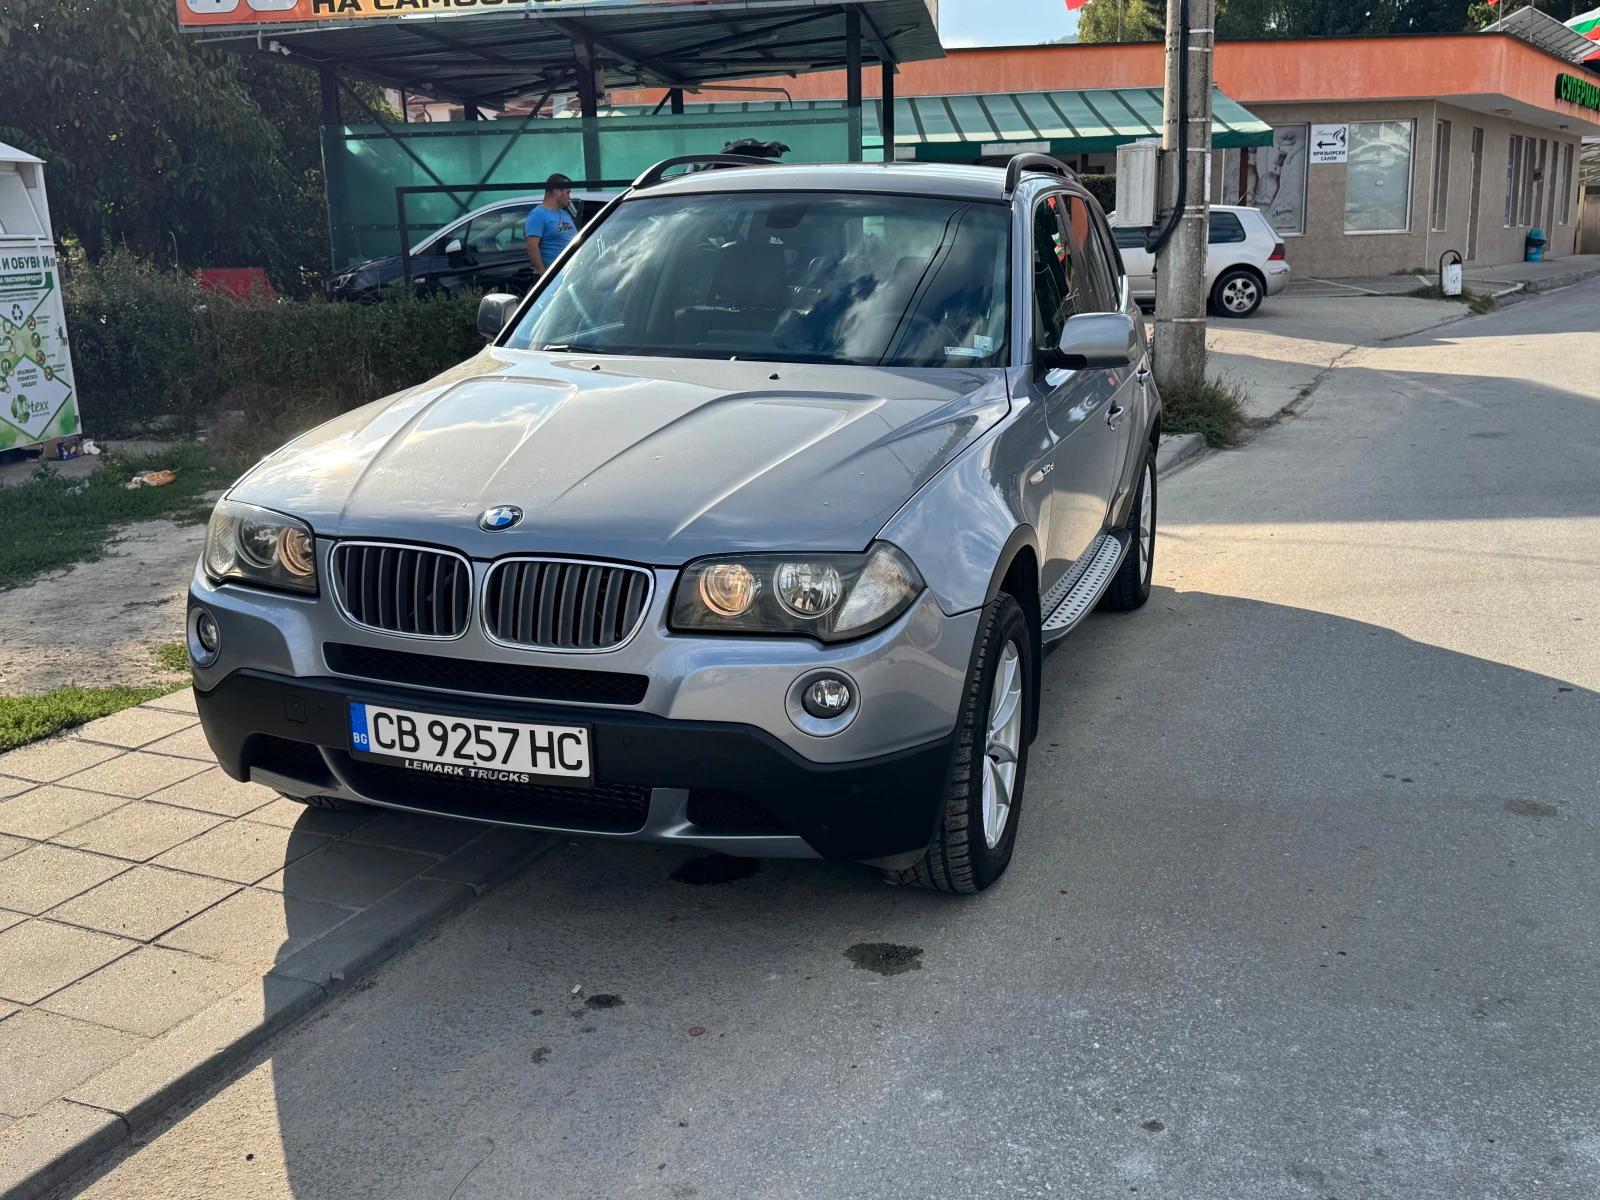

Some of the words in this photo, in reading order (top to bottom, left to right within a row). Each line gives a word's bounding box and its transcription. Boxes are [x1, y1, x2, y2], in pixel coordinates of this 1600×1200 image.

[1561, 72, 1600, 111] СУПЕРМАР
[353, 732, 368, 745] BG
[373, 711, 420, 753] CB
[427, 720, 520, 764] 9257
[529, 729, 583, 770] HC
[404, 759, 464, 776] LEMARK
[469, 768, 530, 783] TRUCKS
